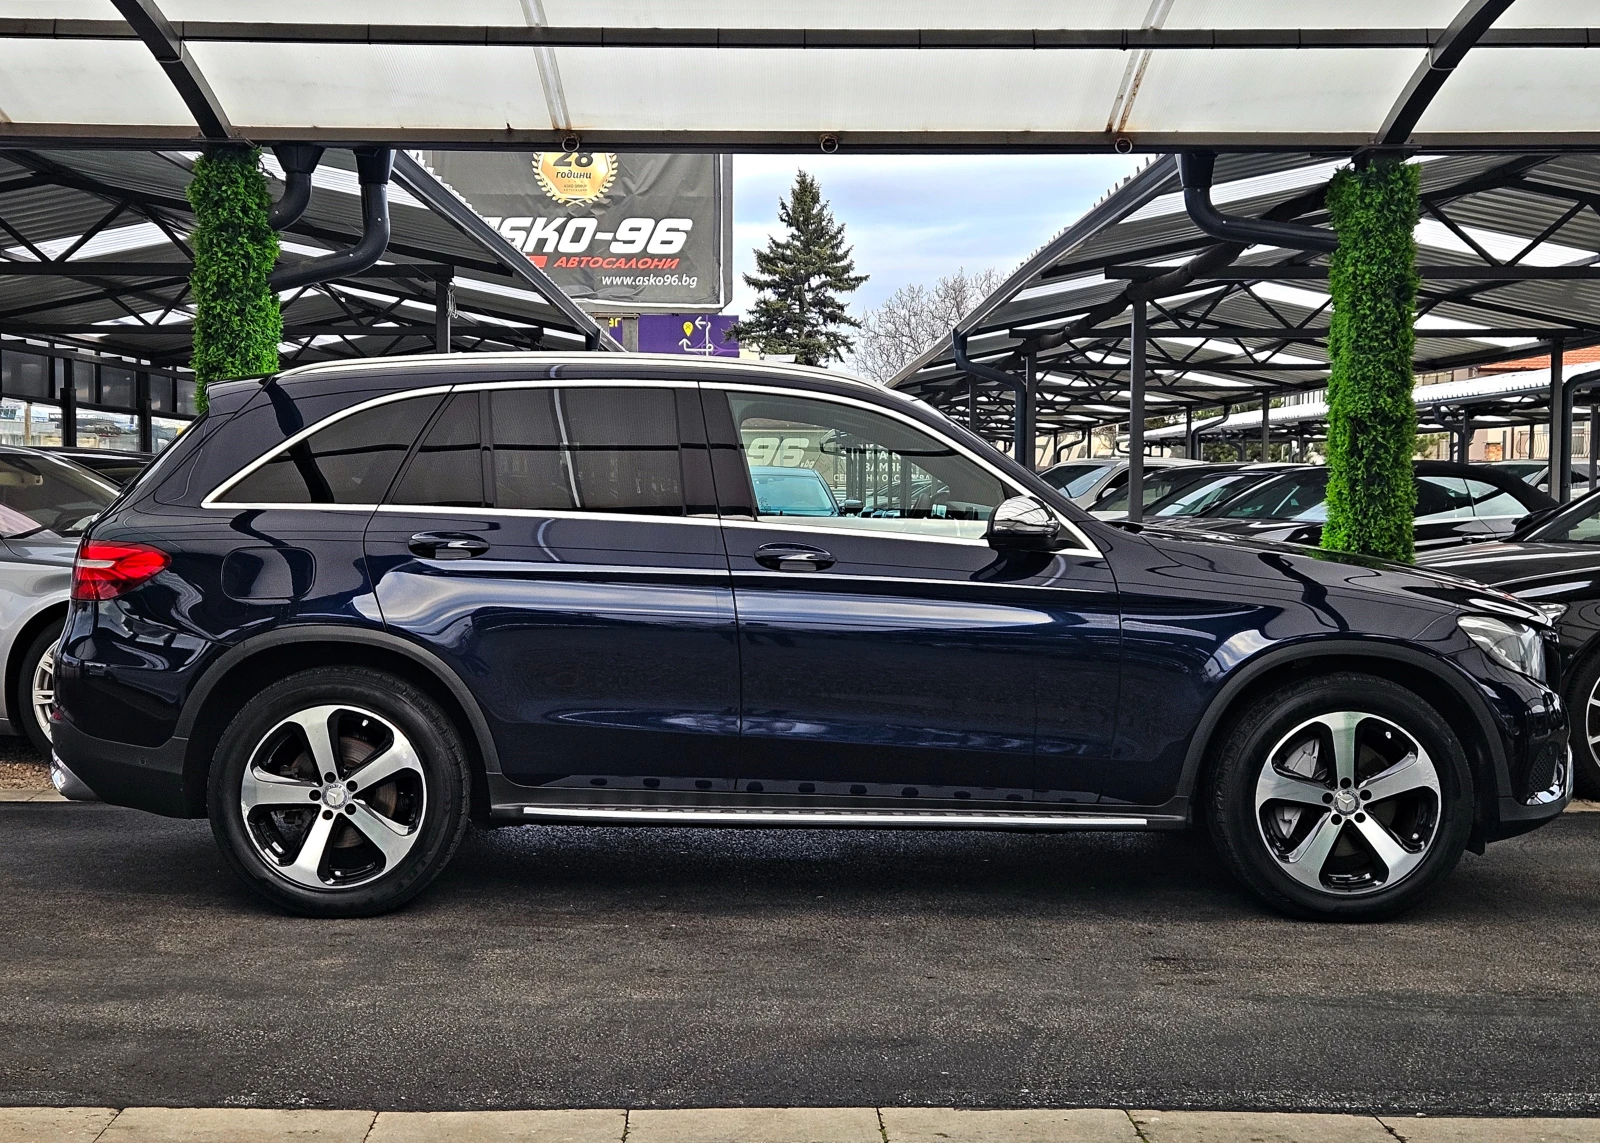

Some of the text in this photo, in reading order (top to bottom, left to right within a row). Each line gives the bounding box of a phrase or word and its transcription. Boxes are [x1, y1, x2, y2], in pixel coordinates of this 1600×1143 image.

[556, 169, 592, 179] години
[553, 256, 680, 269] АВТОСАЛОНИ
[601, 274, 698, 288] www.asko96.bg
